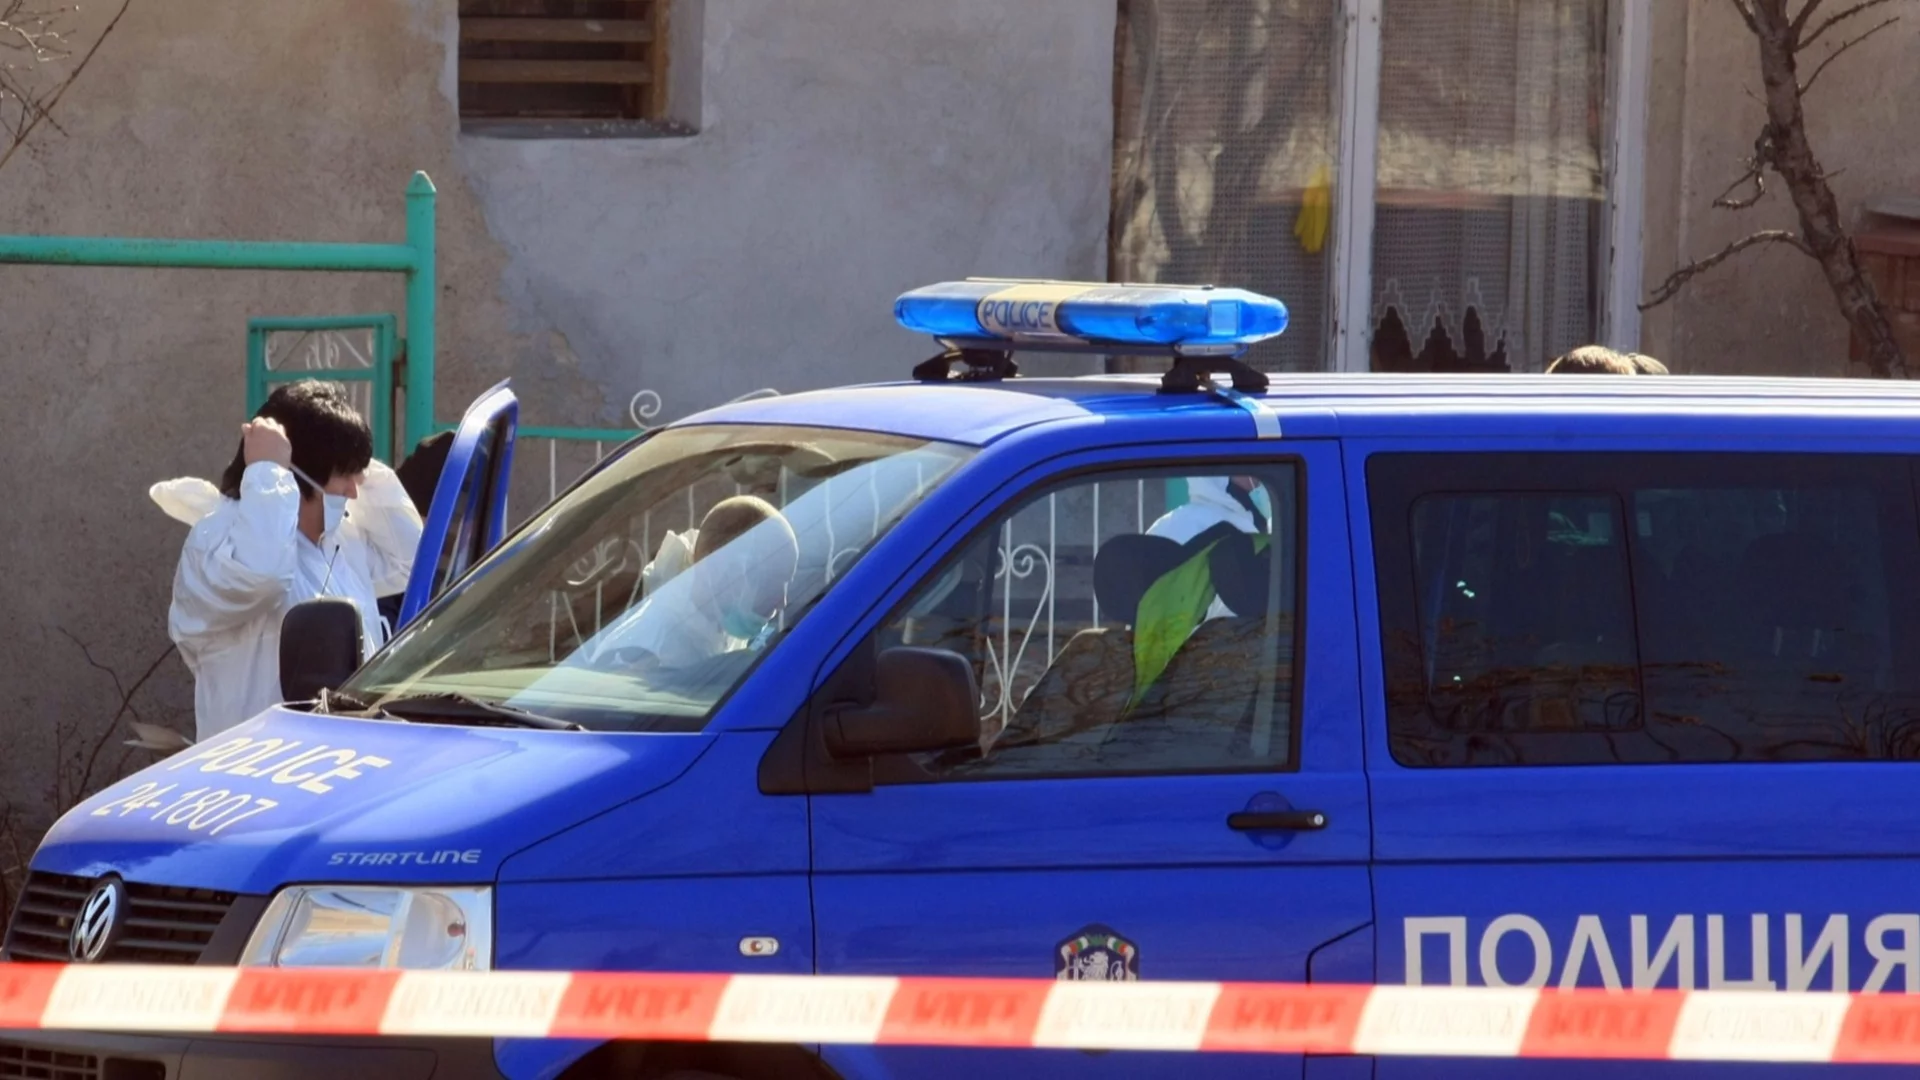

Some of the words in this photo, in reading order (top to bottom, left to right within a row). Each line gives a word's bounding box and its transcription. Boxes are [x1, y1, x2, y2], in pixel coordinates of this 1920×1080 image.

[983, 300, 1053, 328] POLICE
[167, 737, 392, 795] POLICE
[90, 782, 279, 836] 24-1807
[327, 849, 481, 866] STARTLINE
[1404, 913, 1920, 992] ПОЛИЦИЯ
